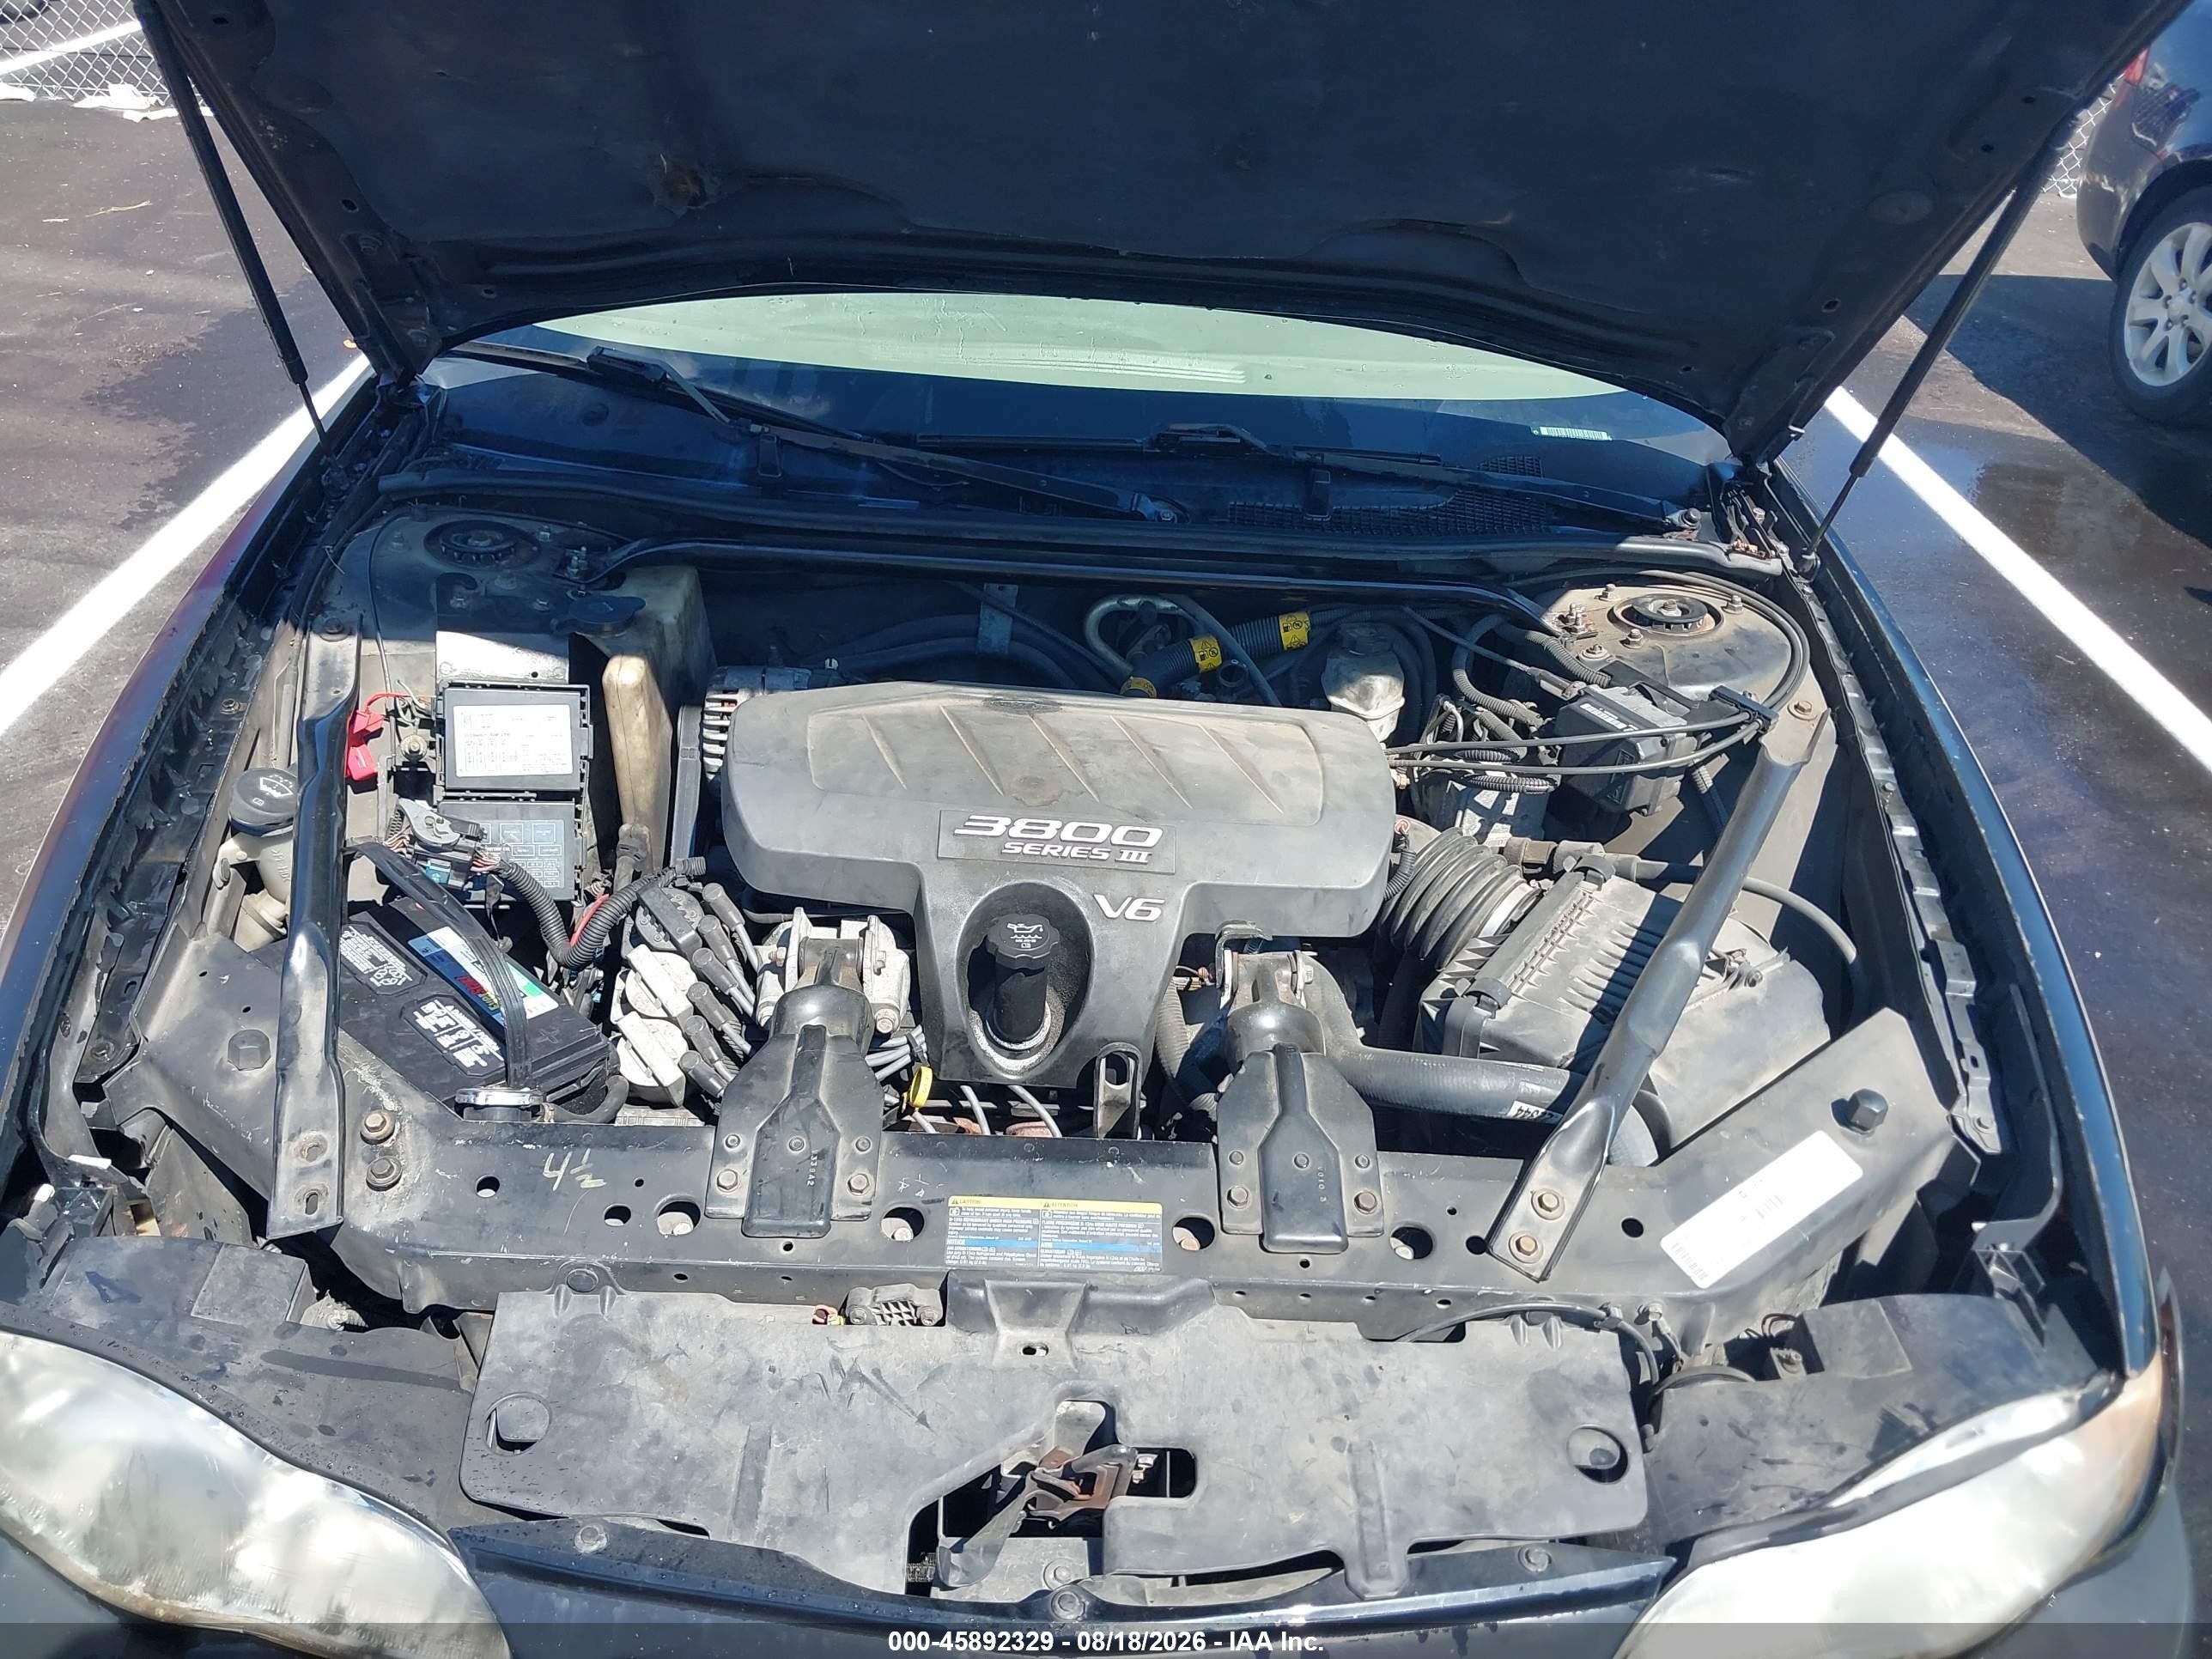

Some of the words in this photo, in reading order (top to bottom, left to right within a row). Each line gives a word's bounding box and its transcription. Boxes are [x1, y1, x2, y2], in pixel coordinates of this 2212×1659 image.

[954, 814, 1164, 848] 3800
[1001, 842, 1112, 861] SERIES
[1115, 849, 1154, 865] III
[1093, 893, 1166, 922] V6
